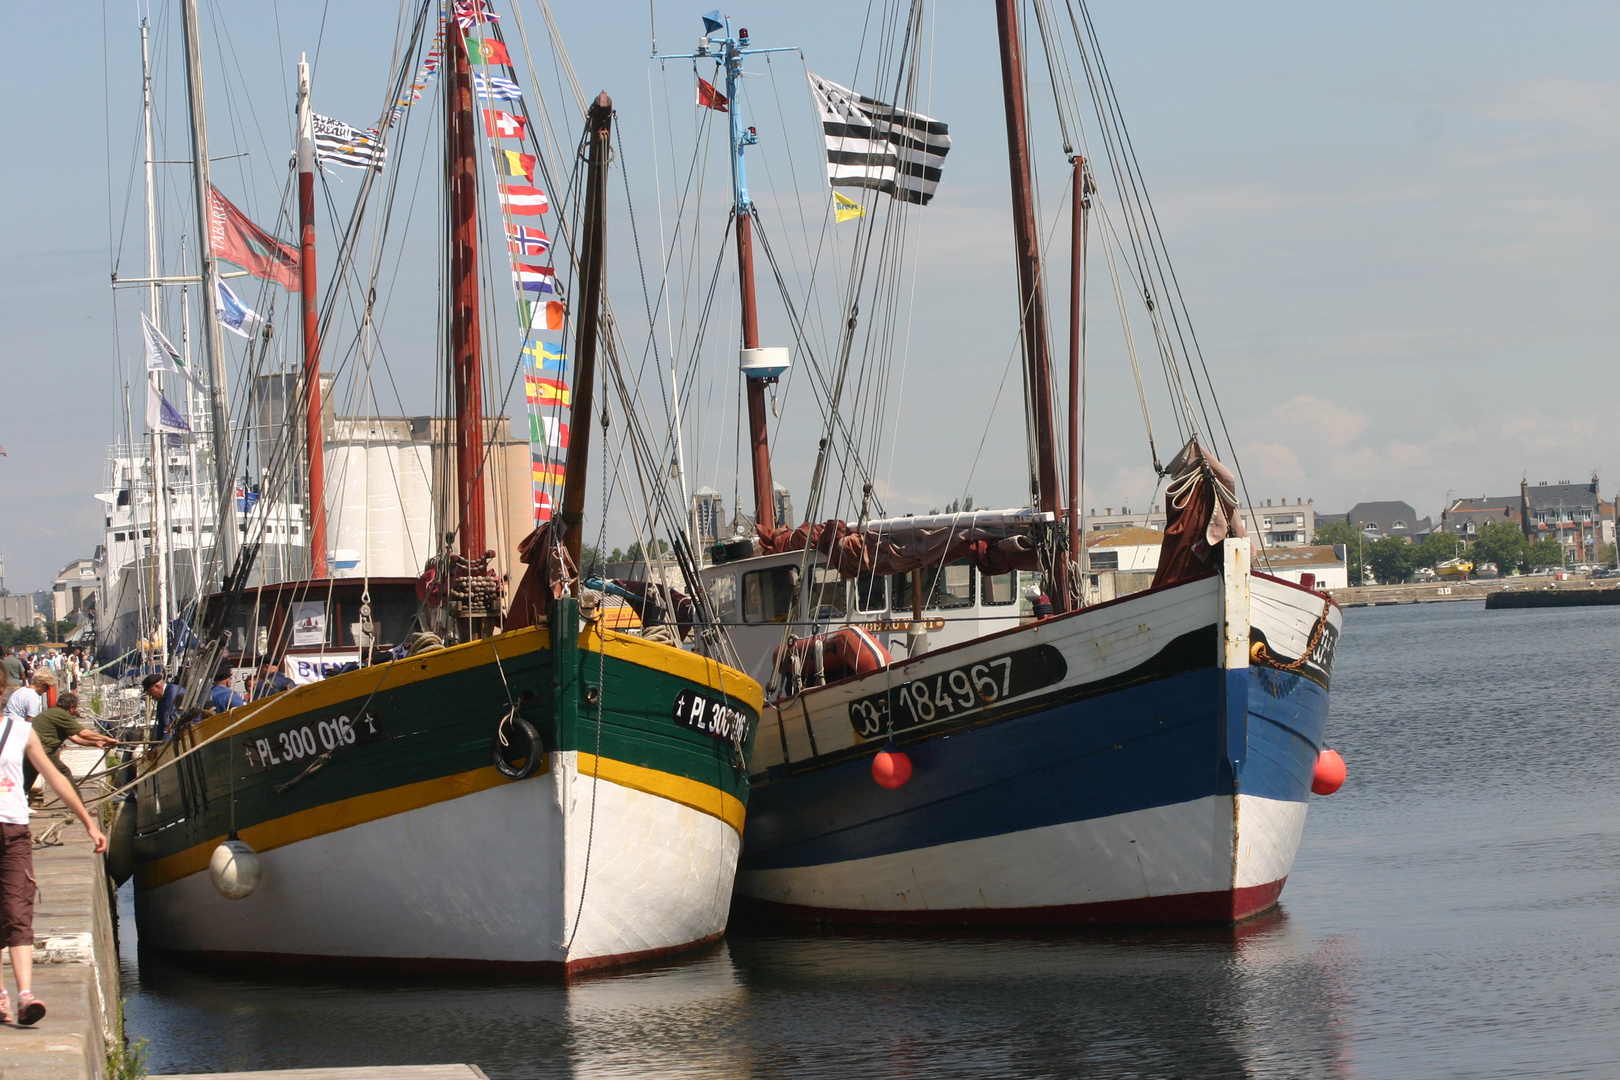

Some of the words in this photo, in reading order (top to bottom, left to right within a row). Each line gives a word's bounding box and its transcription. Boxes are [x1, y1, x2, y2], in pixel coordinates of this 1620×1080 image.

[689, 696, 707, 729] PL
[899, 656, 1012, 723] 184967
[256, 737, 280, 768] PL
[279, 725, 317, 762] 300
[318, 715, 356, 751] 016
